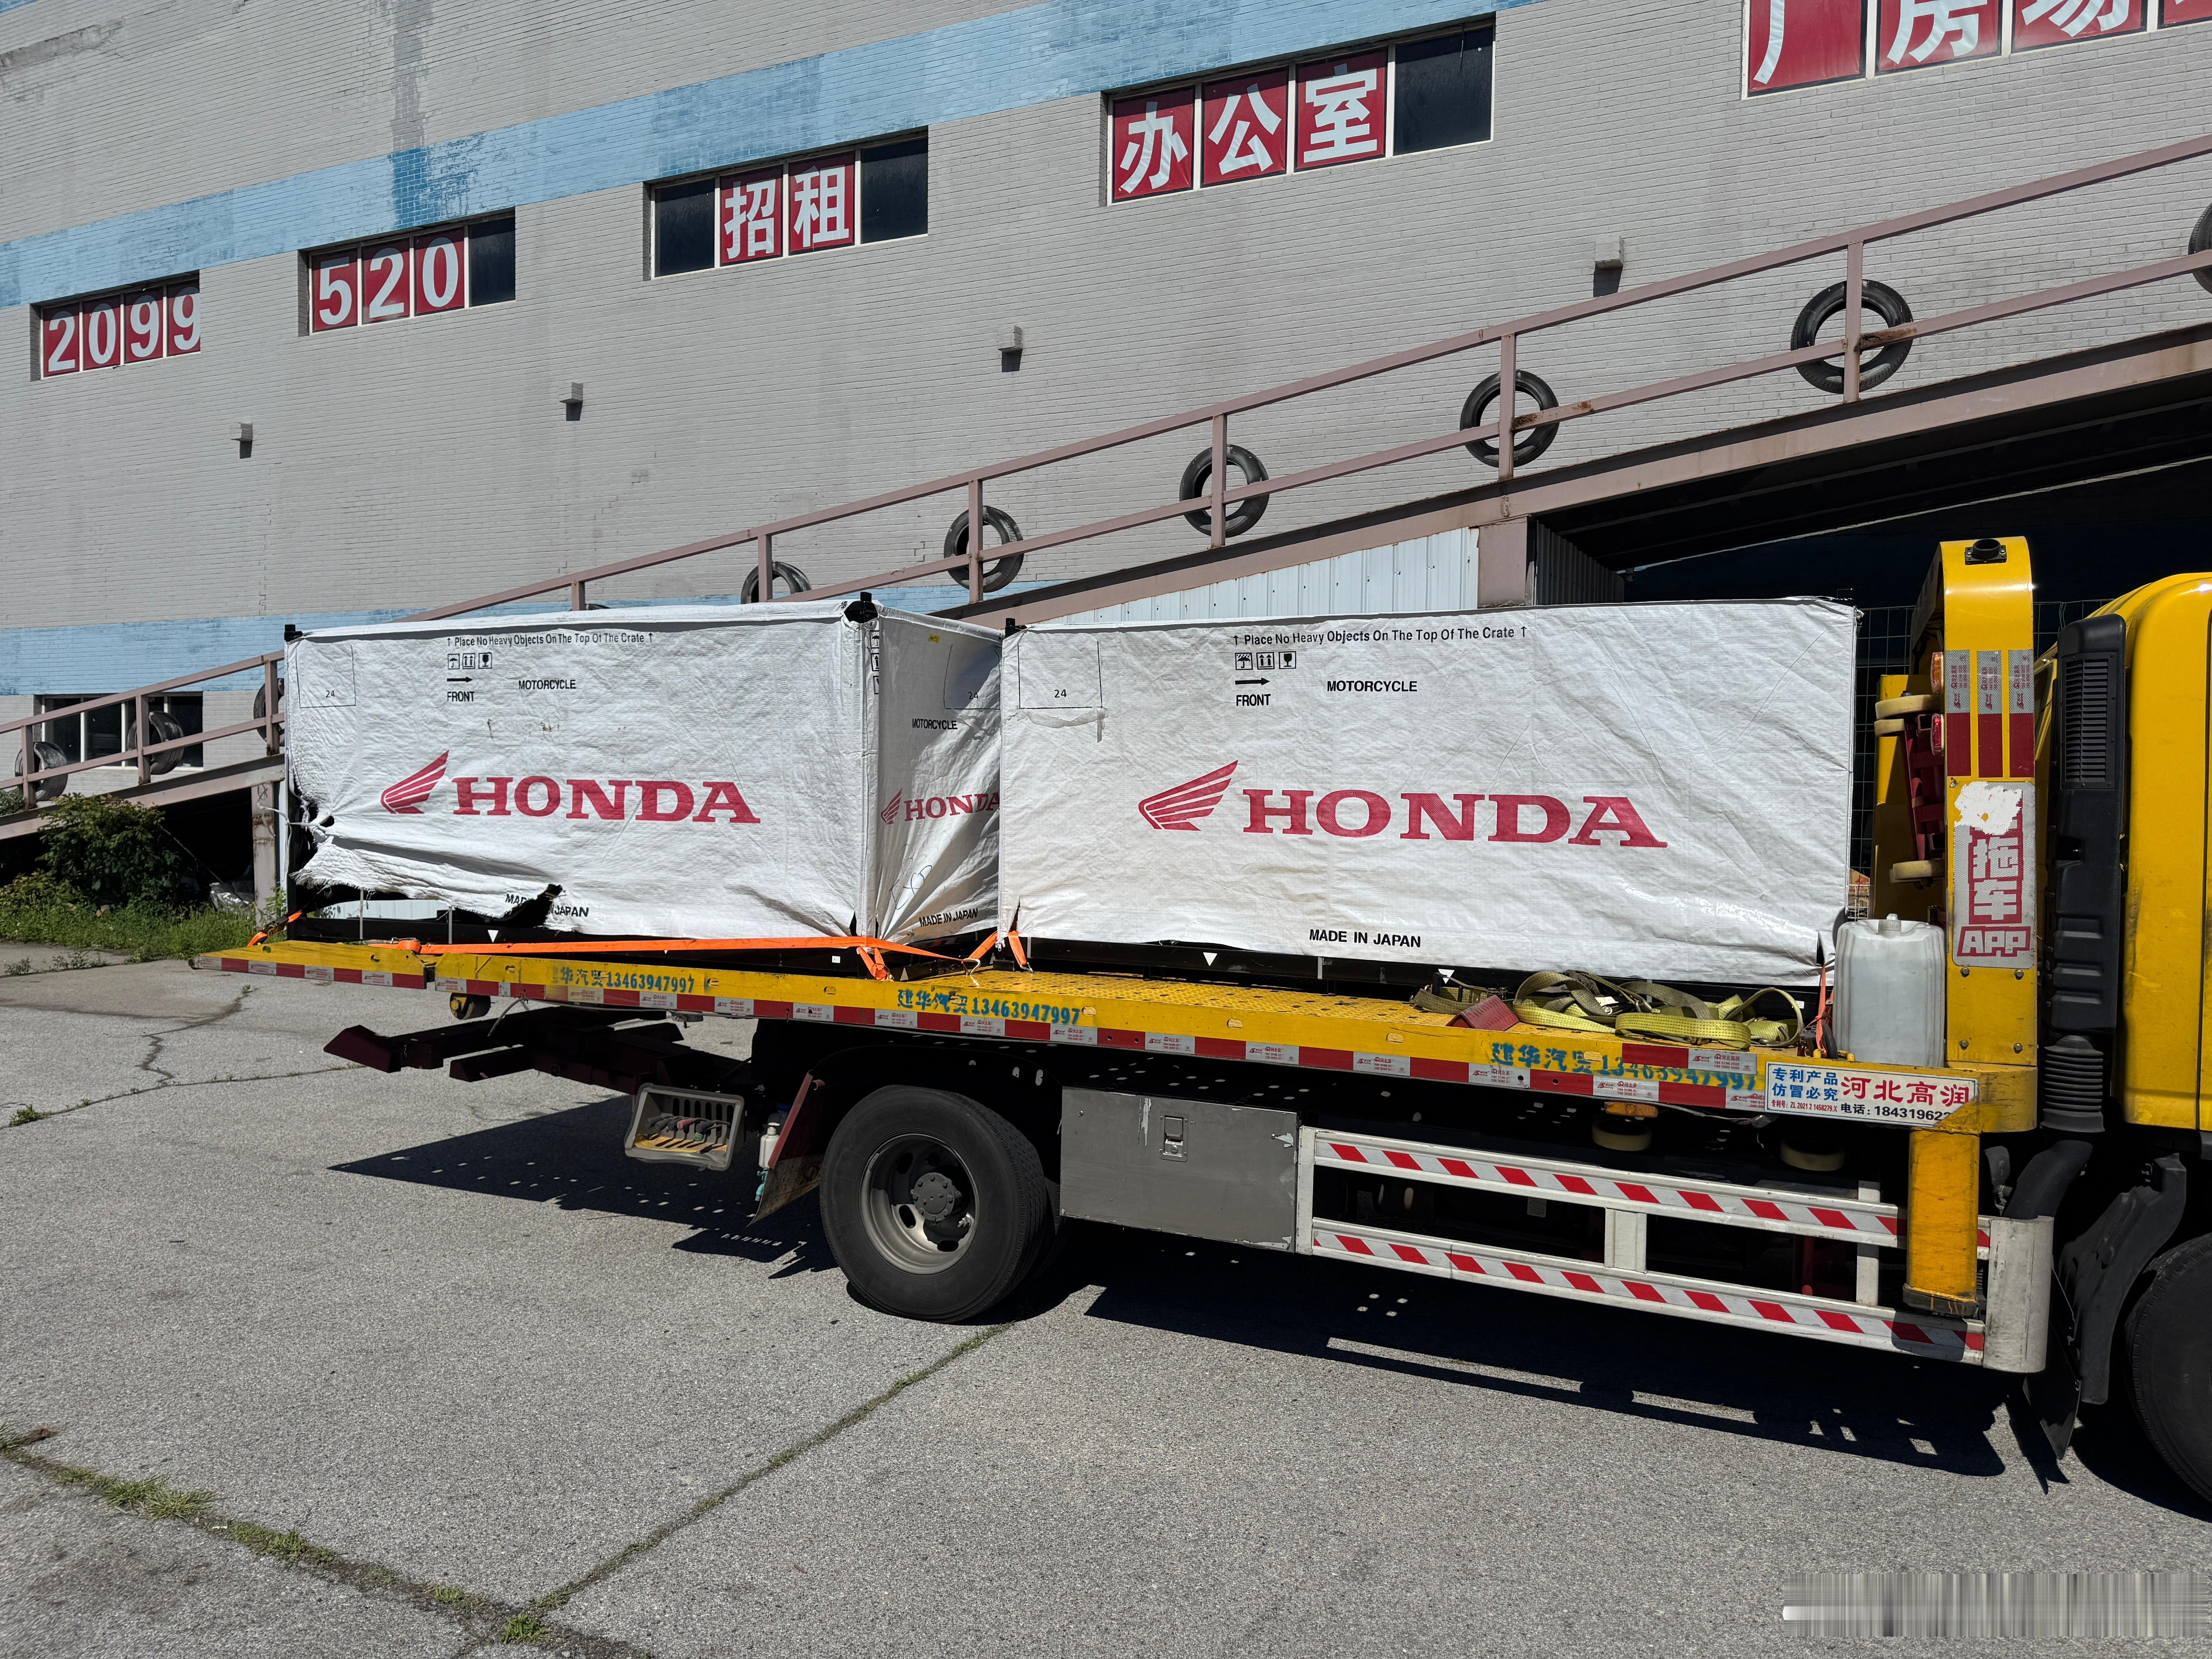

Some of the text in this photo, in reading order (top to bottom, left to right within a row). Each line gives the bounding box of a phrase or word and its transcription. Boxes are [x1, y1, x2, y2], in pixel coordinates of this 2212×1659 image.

[1119, 63, 1378, 194] 办公室
[724, 164, 850, 259] 招租
[319, 237, 460, 326] 520
[47, 287, 201, 373] 2099
[455, 632, 645, 647] Place No Heavy Objects On The Top Of The Crate
[1244, 627, 1514, 646] Place No Heavy Objects On The Top Of The Crate
[325, 689, 335, 698] 24
[518, 680, 576, 690] MOTORCYCLE
[1054, 689, 1067, 698] 24
[1327, 680, 1417, 692] MOTORCYCLE
[447, 691, 475, 702] FRONT
[969, 692, 979, 700] 24
[1235, 694, 1271, 707] FRONT
[912, 718, 958, 730] MOTORCYCLE
[452, 775, 761, 824] HONDA
[904, 792, 1000, 821] HONDA
[1243, 788, 1669, 848] HONDA
[555, 905, 589, 917] JAPAN
[919, 908, 978, 927] MADE IN JAPAN
[1309, 929, 1421, 947] MADE IN JAPAN
[1961, 930, 2027, 954] APP
[606, 972, 694, 994] 13463947997
[972, 998, 1080, 1025] 13463947997
[1772, 1067, 1838, 1086] 专利产品
[1772, 1083, 1839, 1101] 仿冒必究
[1841, 1076, 1969, 1107] 河北高润
